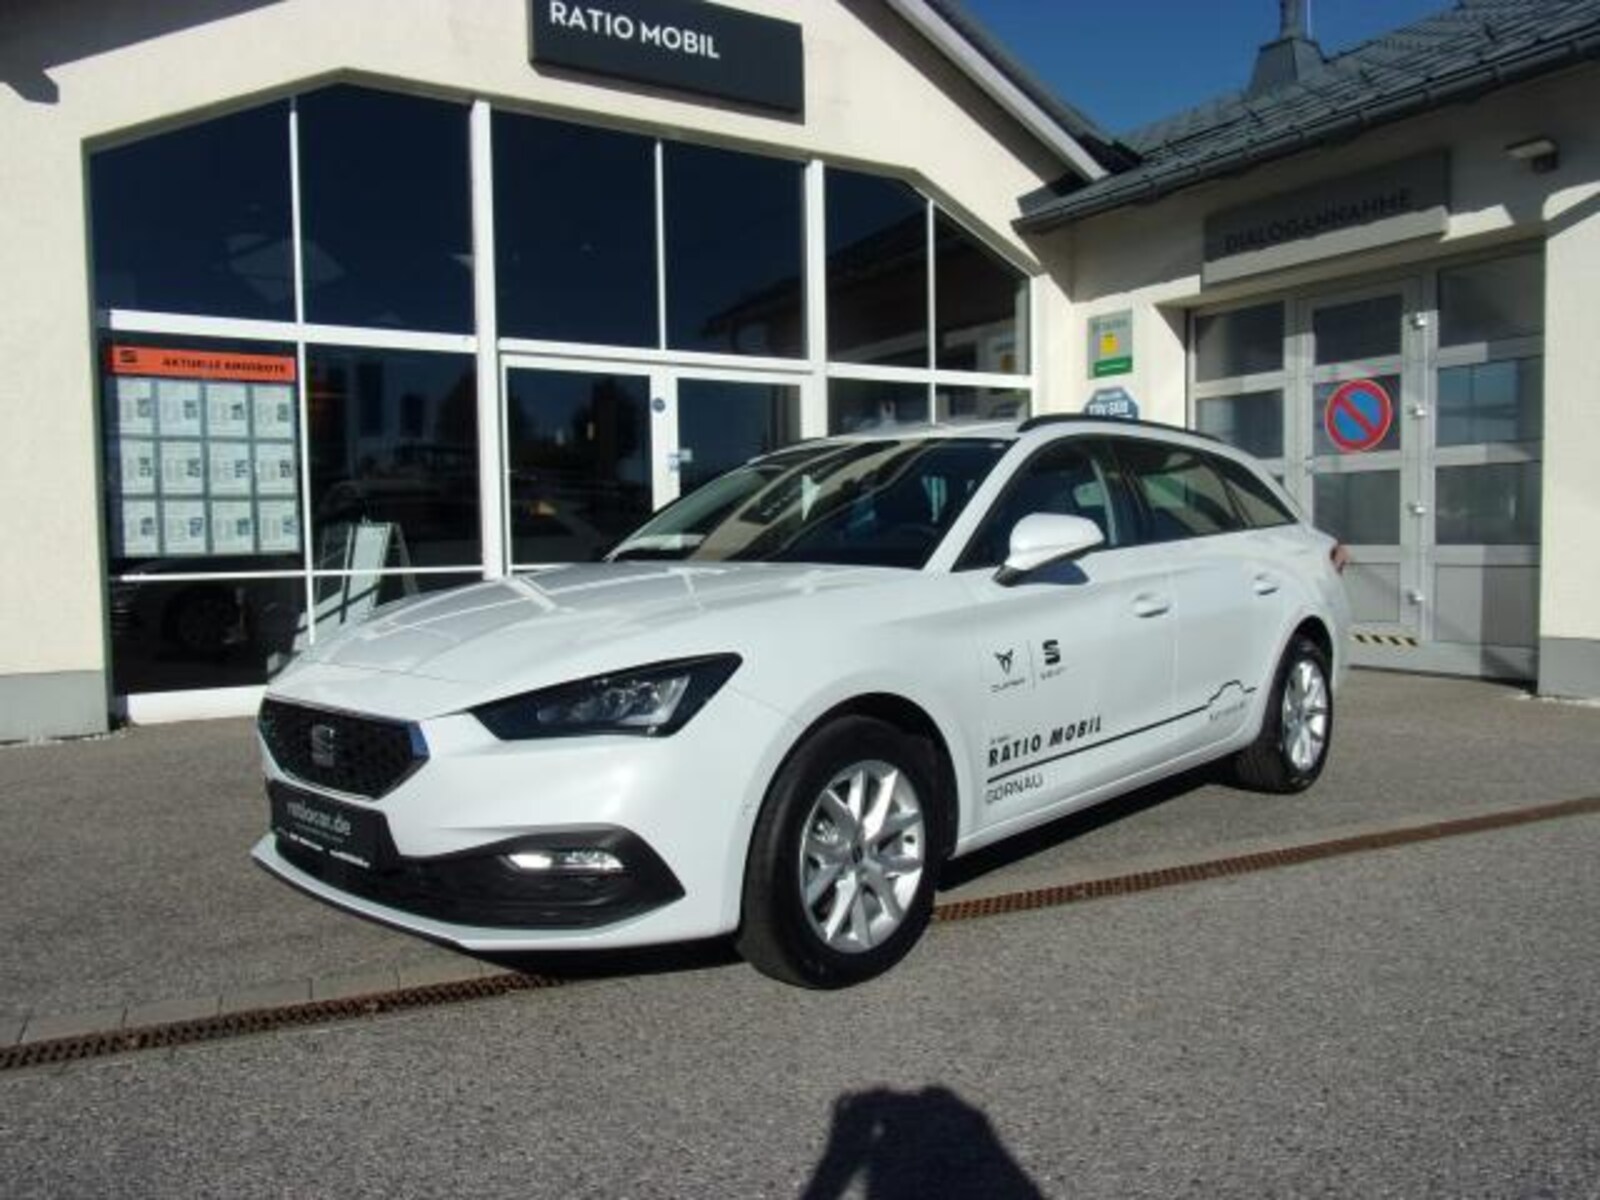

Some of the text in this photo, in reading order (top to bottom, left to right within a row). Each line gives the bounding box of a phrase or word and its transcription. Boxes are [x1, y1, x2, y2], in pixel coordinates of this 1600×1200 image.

[549, 2, 720, 59] RATIO MOBIL
[988, 715, 1102, 768] RATIO MOBIL
[985, 773, 1044, 804] GORNAU
